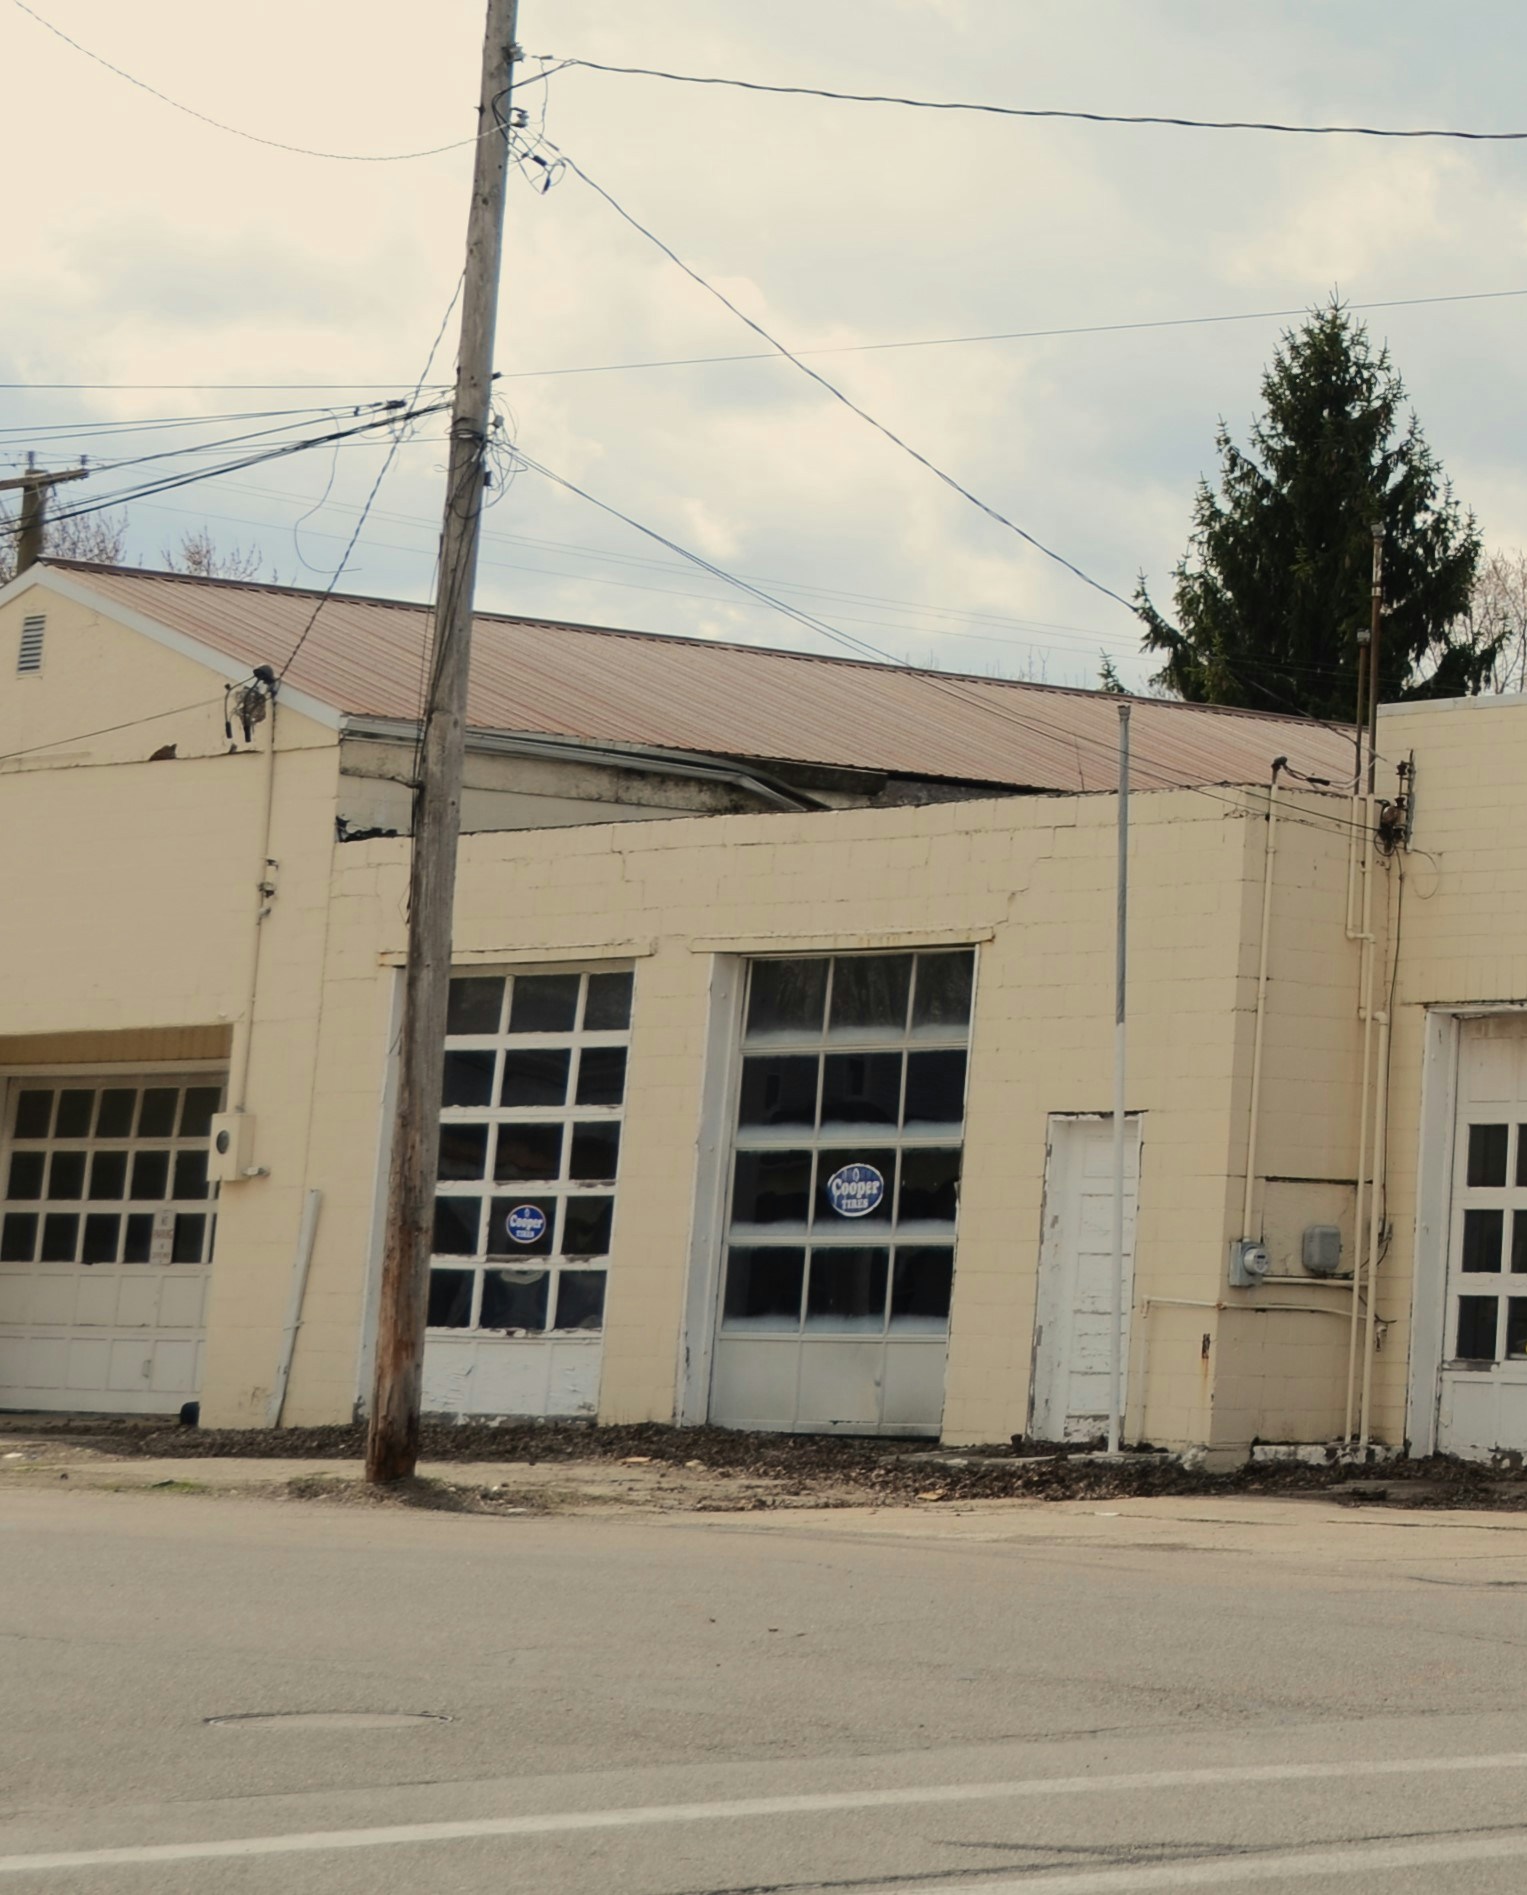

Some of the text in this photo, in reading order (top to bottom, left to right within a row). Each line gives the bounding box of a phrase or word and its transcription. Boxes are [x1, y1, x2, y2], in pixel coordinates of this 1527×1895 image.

[831, 1178, 880, 1199] Cooper
[842, 1199, 868, 1209] TIRES
[510, 1214, 543, 1230] Cooper
